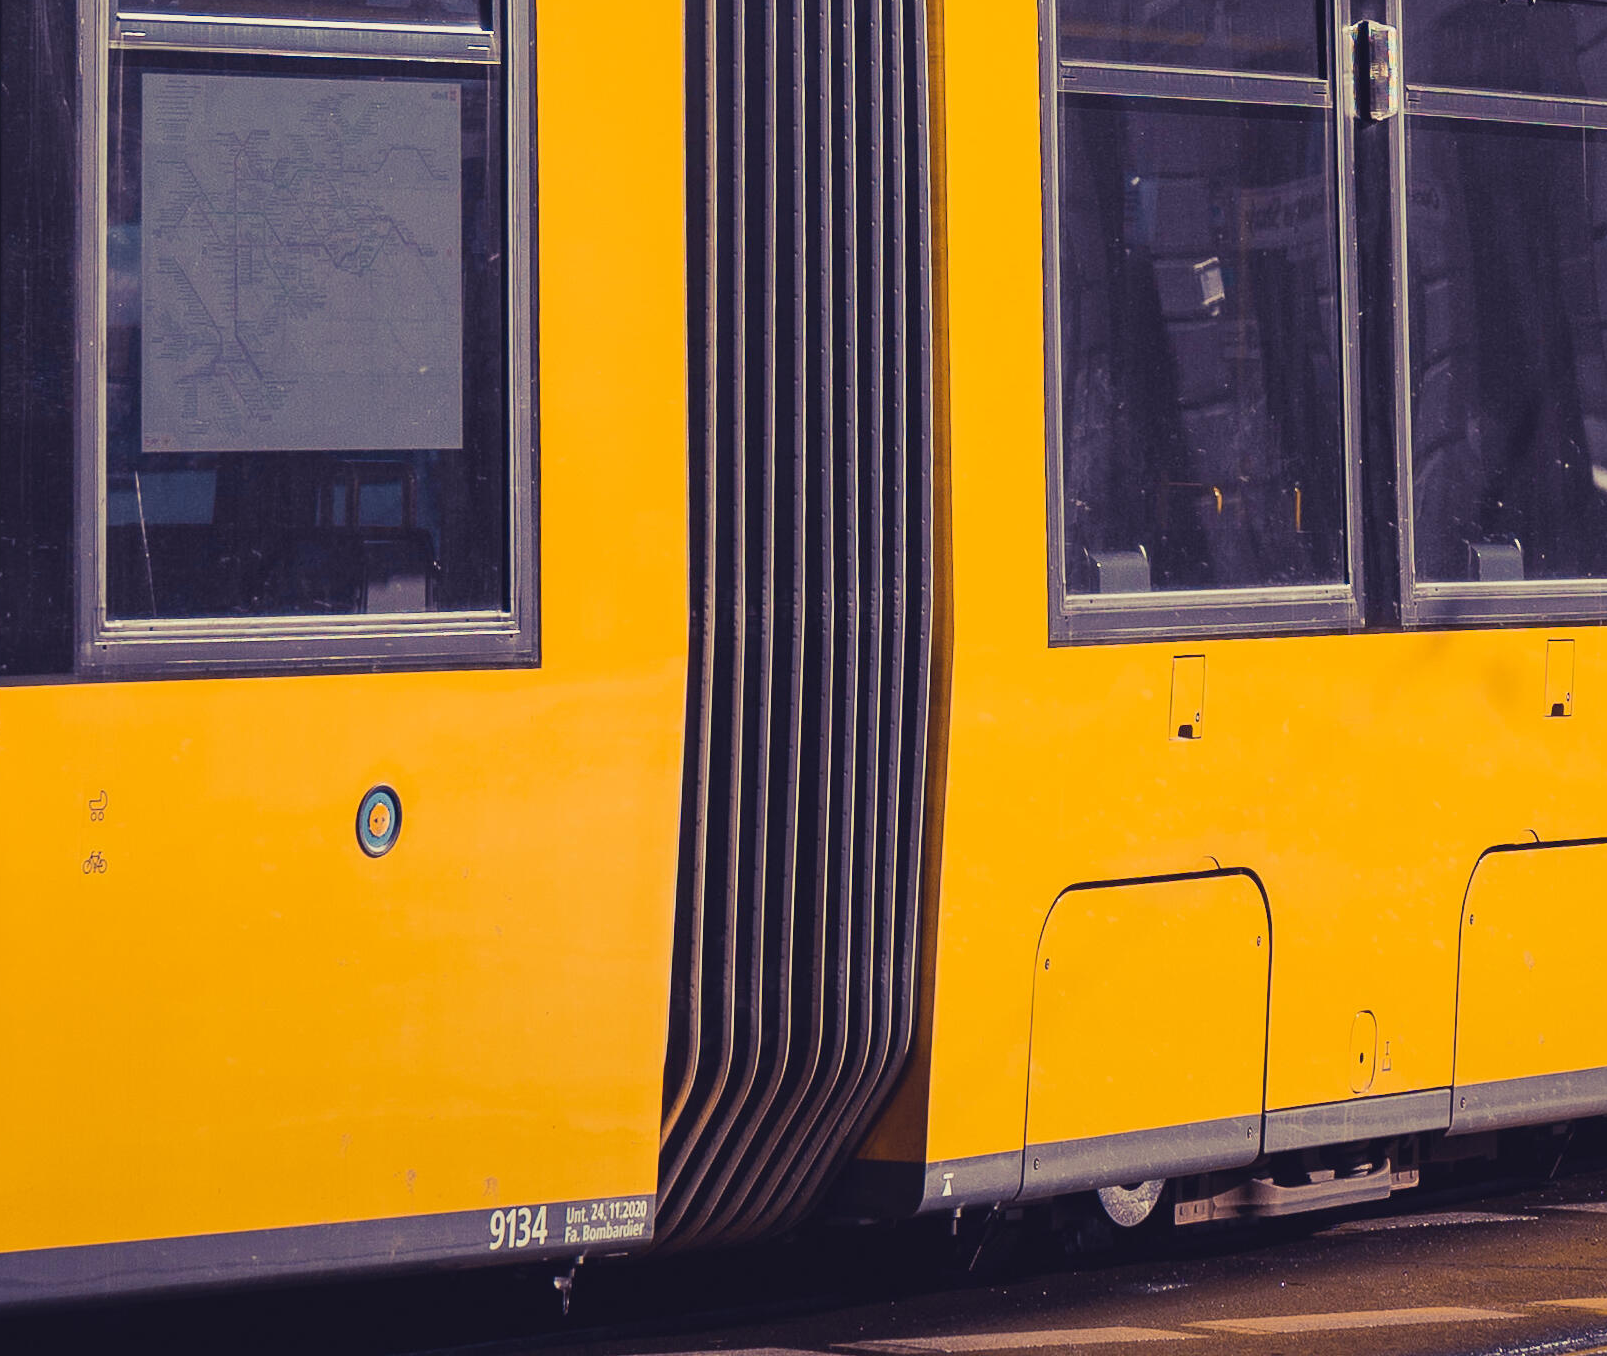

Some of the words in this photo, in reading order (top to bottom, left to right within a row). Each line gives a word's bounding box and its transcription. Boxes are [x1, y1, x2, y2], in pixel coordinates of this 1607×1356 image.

[489, 1206, 548, 1249] 9134
[566, 1206, 589, 1224] Unt.
[564, 1225, 580, 1244] Fa.
[582, 1219, 645, 1242] Bombardier
